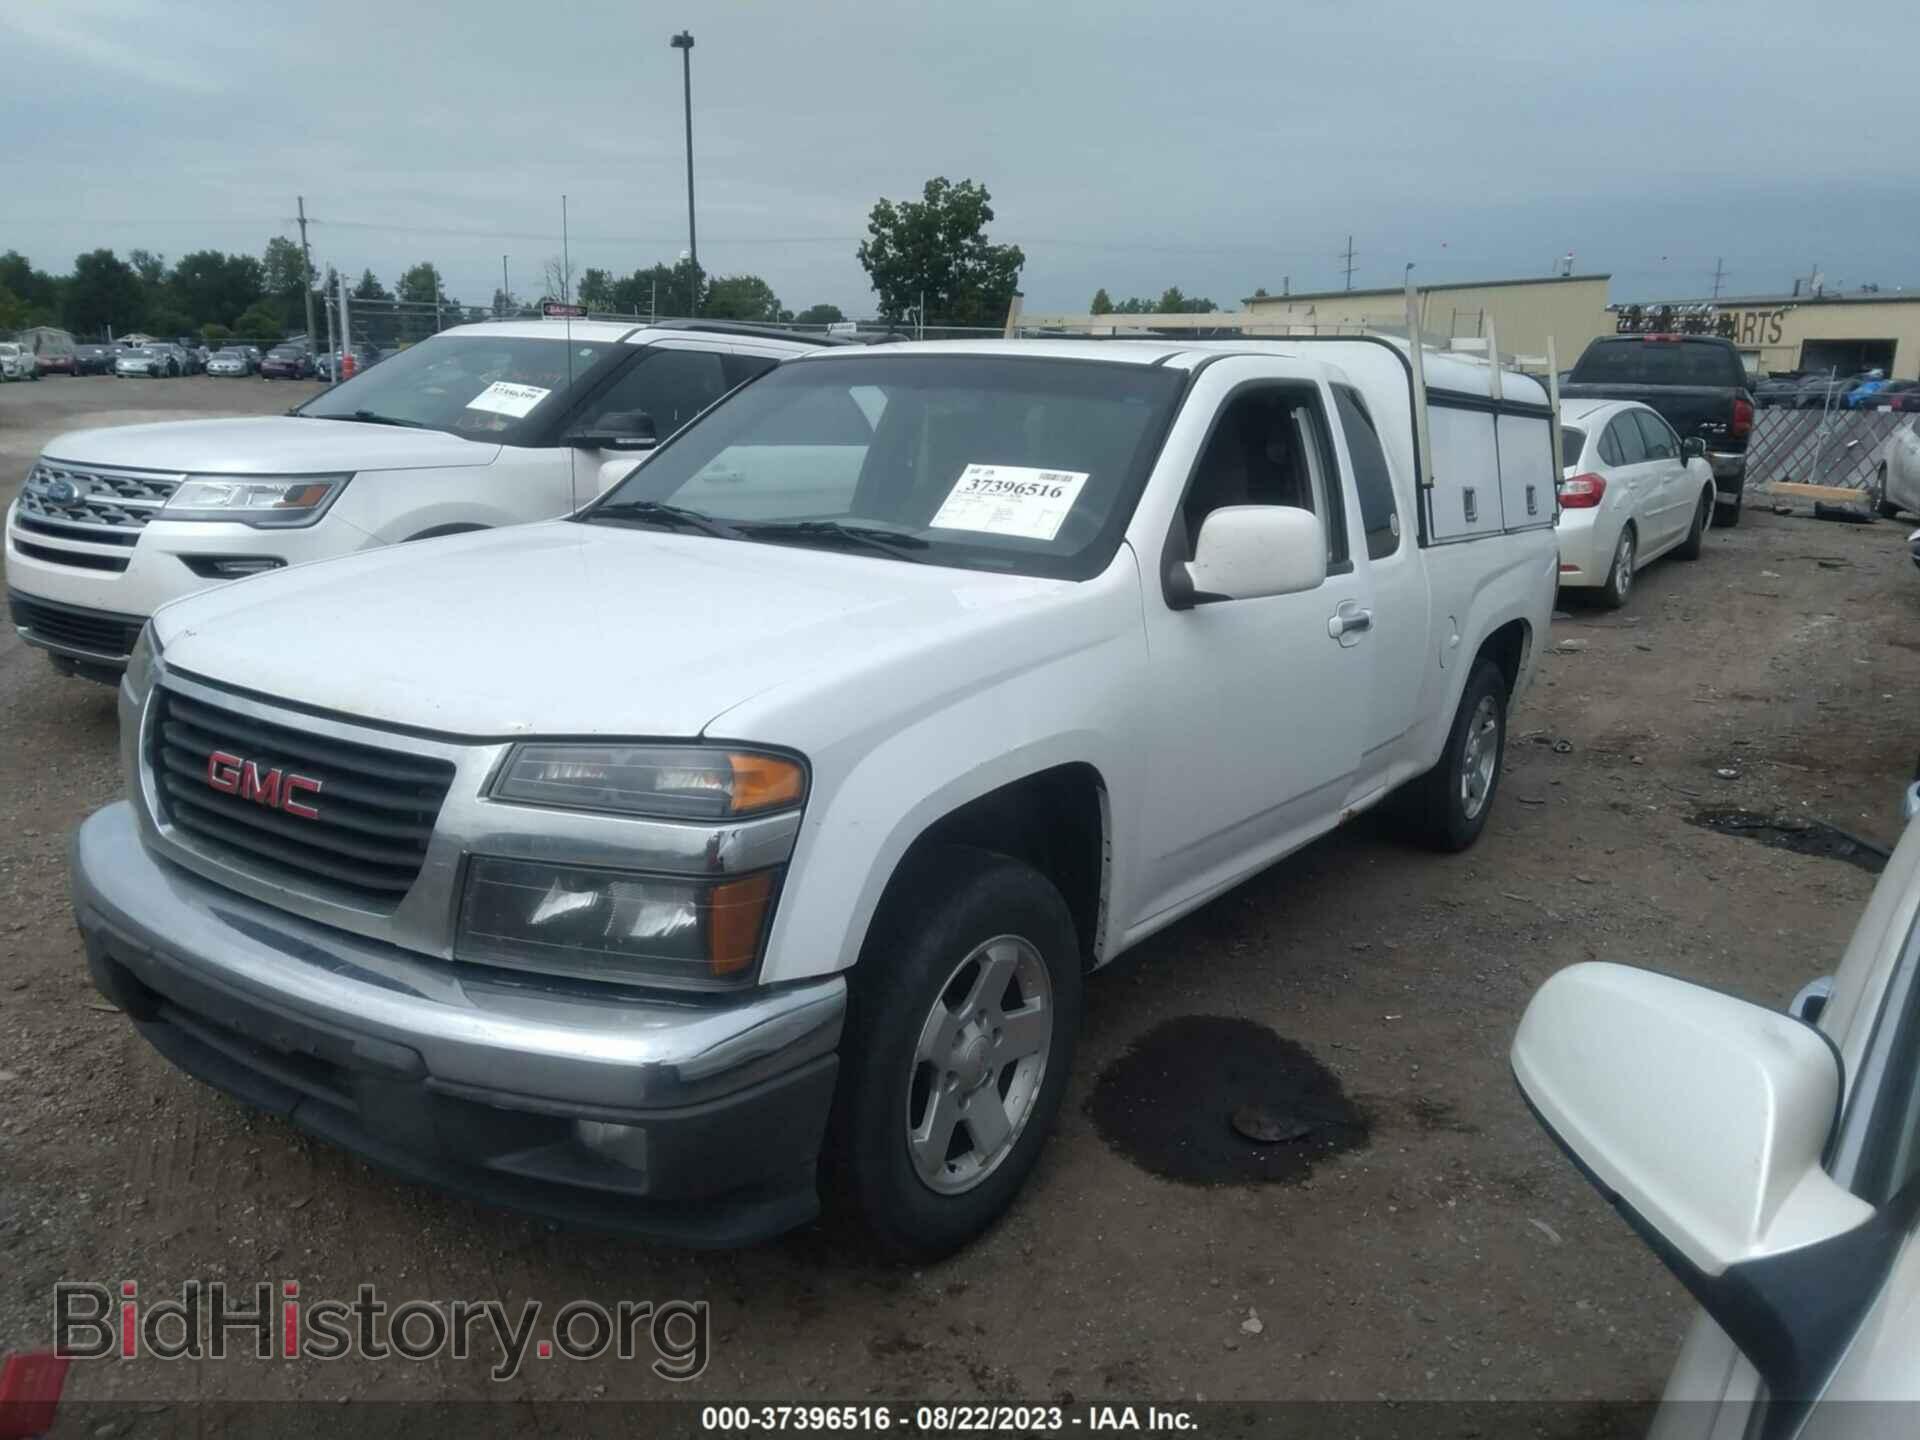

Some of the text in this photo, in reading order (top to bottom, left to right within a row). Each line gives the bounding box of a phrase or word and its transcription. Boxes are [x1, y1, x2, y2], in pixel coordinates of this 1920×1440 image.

[1719, 311, 1784, 344] PARTS
[966, 478, 1063, 498] 37396516
[206, 750, 323, 820] GMC
